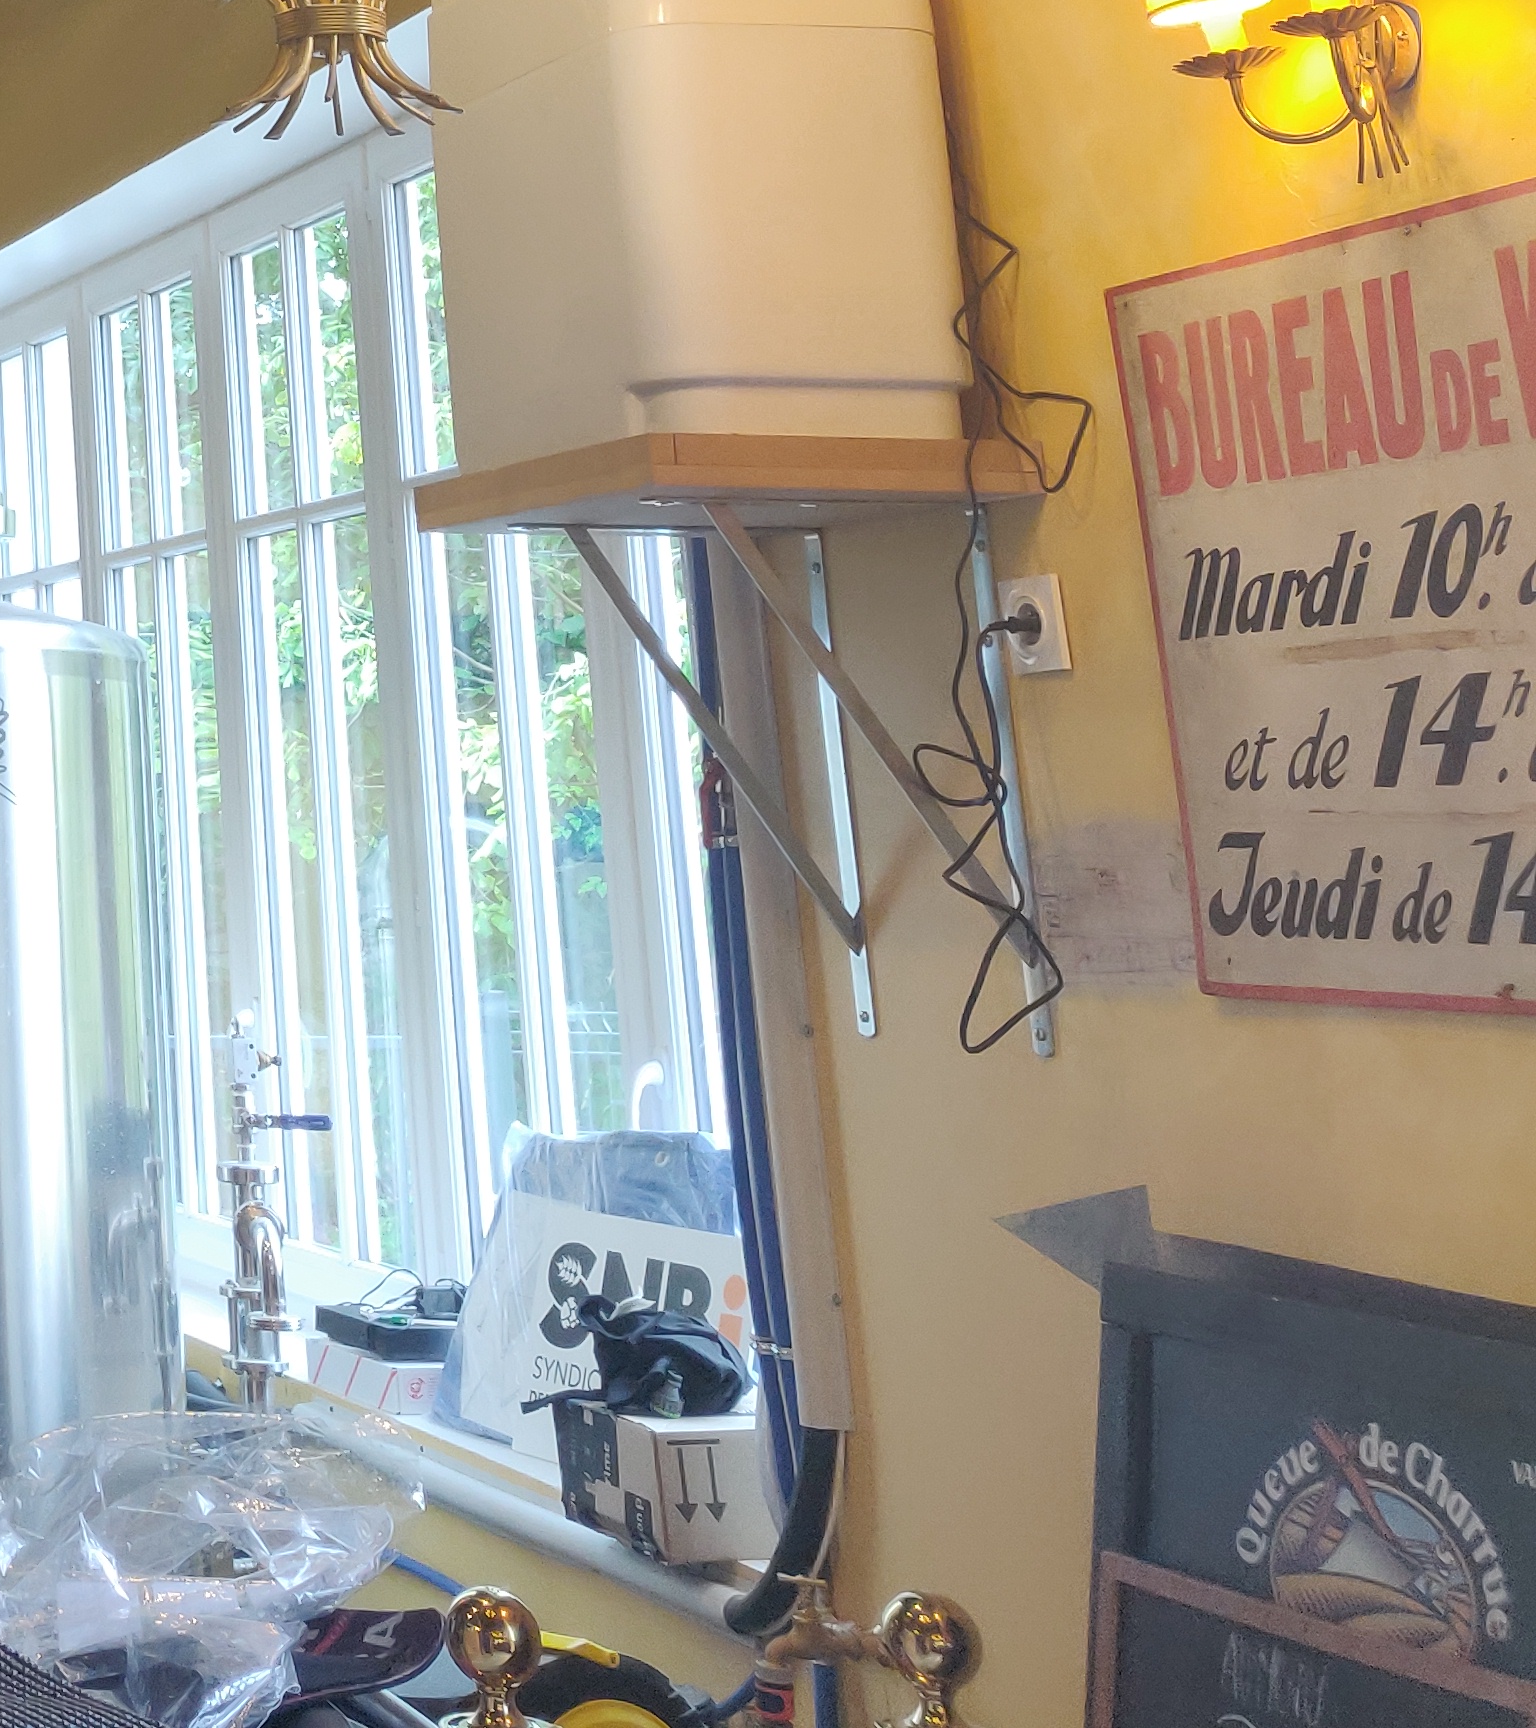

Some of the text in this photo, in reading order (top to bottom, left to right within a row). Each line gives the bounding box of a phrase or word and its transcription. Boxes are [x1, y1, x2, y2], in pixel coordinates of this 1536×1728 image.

[1138, 270, 1426, 497] BUREAU
[1429, 339, 1510, 453] DE
[1178, 530, 1371, 643] Mardi
[1225, 733, 1278, 792] et
[1287, 709, 1350, 792] de
[1208, 830, 1383, 941] Jeudi
[1392, 861, 1453, 945] de
[533, 1355, 599, 1390] SYNDIC
[1359, 1422, 1399, 1473] de
